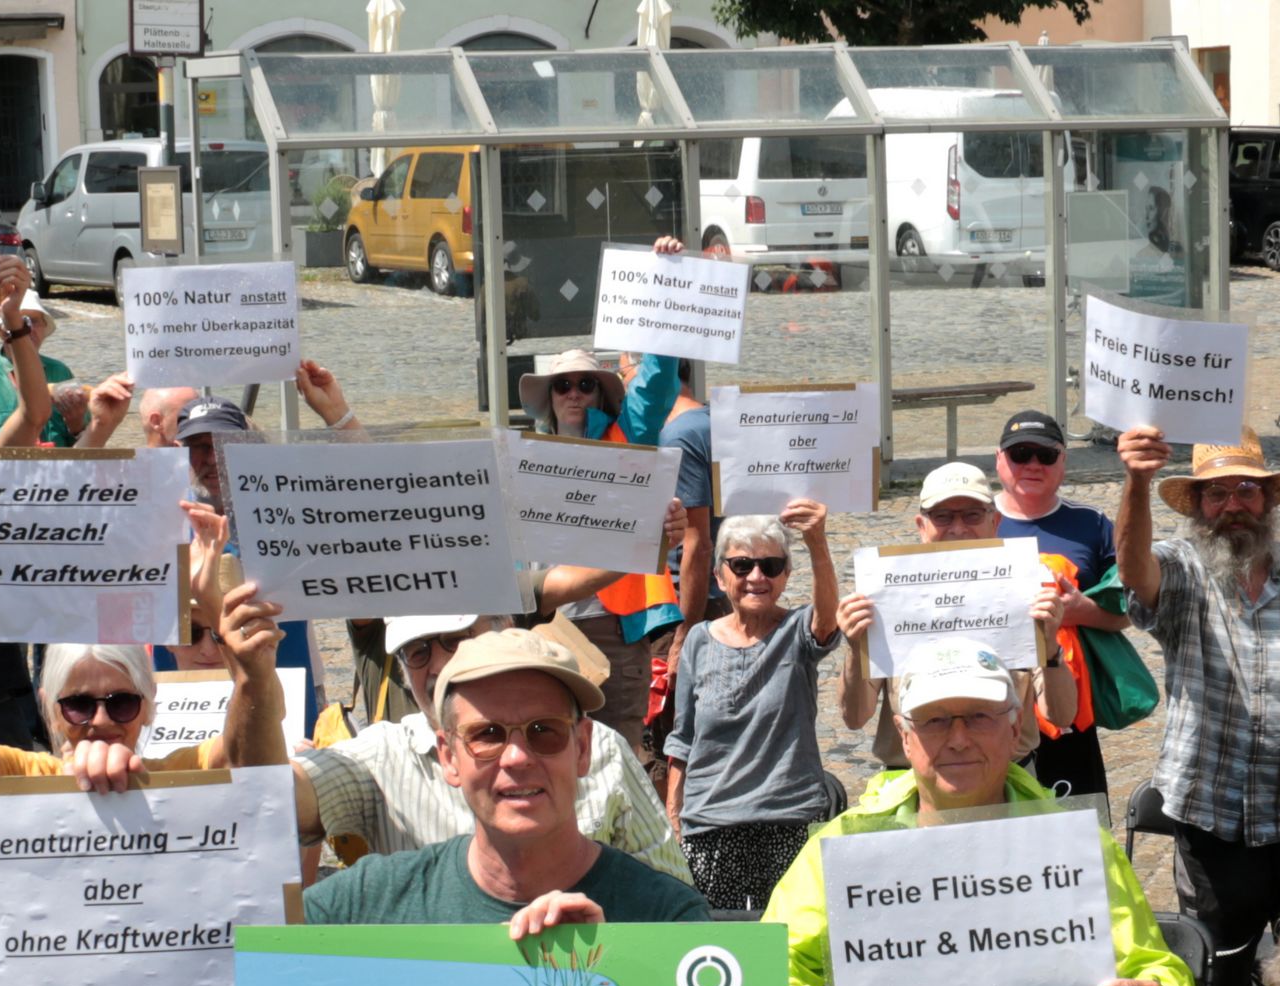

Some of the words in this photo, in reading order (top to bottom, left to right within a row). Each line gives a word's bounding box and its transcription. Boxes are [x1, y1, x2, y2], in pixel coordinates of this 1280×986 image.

[134, 292, 178, 306] 100%
[185, 291, 231, 304] Natur
[240, 292, 286, 302] anstatt
[128, 323, 159, 335] 0,1%
[163, 321, 197, 333] mehr
[202, 318, 294, 332] Überkapazität
[133, 349, 144, 358] in
[149, 347, 169, 358] der
[175, 342, 291, 358] Stromerzeugung!
[1094, 329, 1127, 355] Freie
[1133, 344, 1196, 367] Flüsse
[1204, 353, 1232, 369] für
[1090, 361, 1126, 389] Natur
[1131, 379, 1142, 395] &
[1149, 383, 1234, 404] Mensch!
[740, 411, 829, 424] Renaturierung
[842, 410, 858, 421] Ja!
[789, 436, 817, 447] aber
[519, 459, 616, 482] Renaturierung
[630, 473, 651, 484] Ja!
[748, 462, 779, 472] ohne
[784, 458, 850, 473] Kraftwerke!
[238, 475, 269, 493] 2%
[276, 469, 490, 493] Primärenergieanteil
[13, 484, 69, 502] eine
[78, 484, 137, 503] freie
[565, 490, 597, 502] aber
[253, 507, 295, 525] 13%
[302, 503, 485, 525] Stromerzeugung
[520, 509, 552, 521] ohne
[556, 511, 637, 530] Kraftwerke!
[257, 539, 300, 557] 95%
[307, 537, 402, 555] verbaute
[409, 533, 490, 550] Flüsse:
[11, 563, 170, 582] Kraftwerke!
[885, 569, 978, 584] Renaturierung
[993, 565, 1012, 577] Ja!
[302, 578, 338, 596] ES
[347, 570, 458, 594] REICHT!
[935, 594, 965, 605] aber
[895, 620, 926, 632] ohne
[931, 614, 1008, 630] Kraftwerke!
[168, 698, 210, 711] eine
[152, 727, 220, 740] Salzac
[200, 823, 237, 847] Ja!
[84, 878, 142, 901] aber
[847, 881, 921, 909] Freie
[932, 874, 1032, 901] Flüsse
[1042, 864, 1083, 889] für
[5, 931, 67, 952] ohne
[77, 922, 232, 952] Kraftwerke!
[844, 937, 927, 963] Natur
[937, 932, 958, 955] &
[969, 917, 1096, 952] Mensch!
